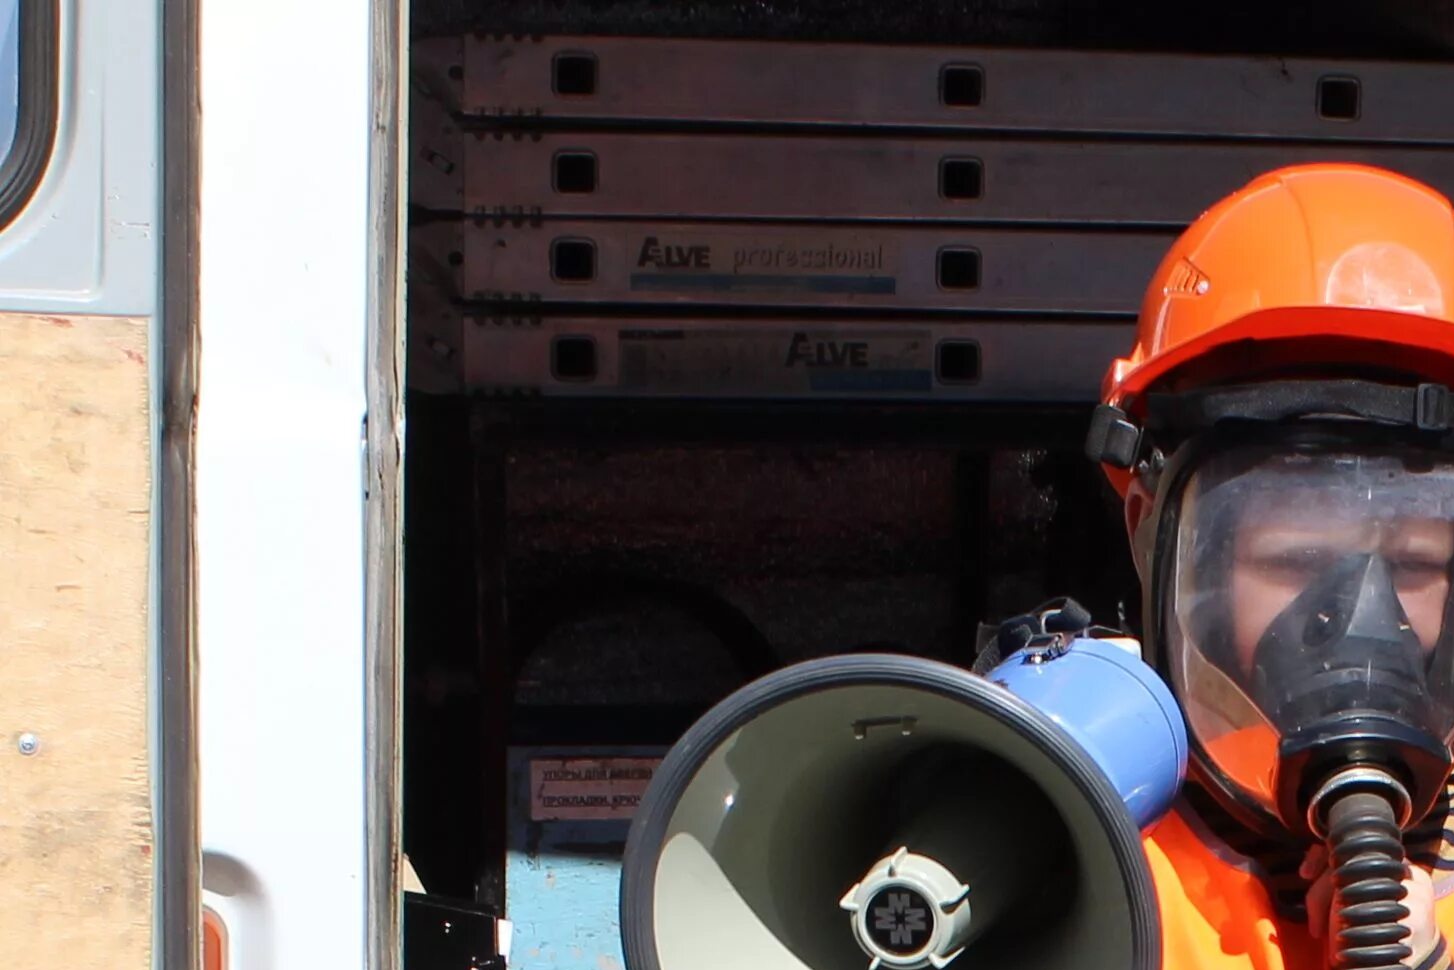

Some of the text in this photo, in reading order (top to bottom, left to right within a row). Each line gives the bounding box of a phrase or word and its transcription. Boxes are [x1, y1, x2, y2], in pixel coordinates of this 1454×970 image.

[638, 235, 883, 273] ALVE professional
[784, 332, 868, 368] ALVE
